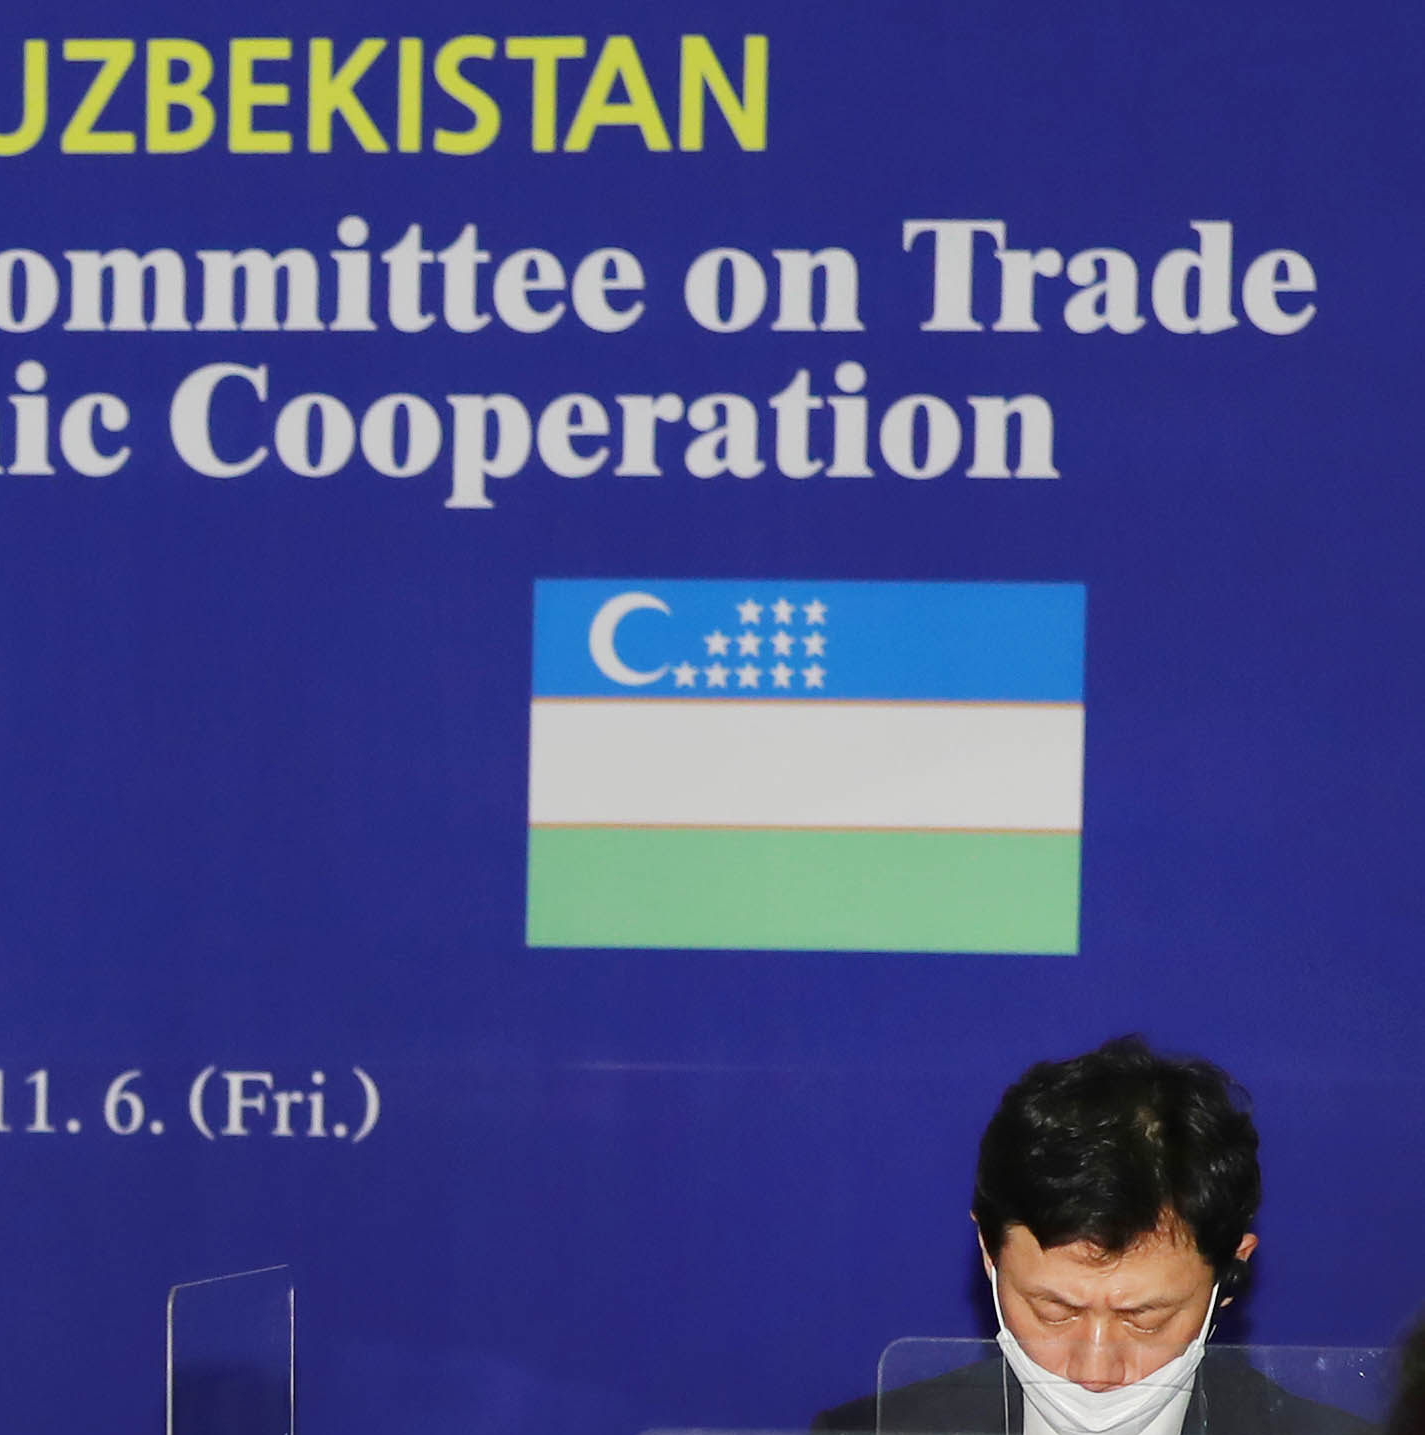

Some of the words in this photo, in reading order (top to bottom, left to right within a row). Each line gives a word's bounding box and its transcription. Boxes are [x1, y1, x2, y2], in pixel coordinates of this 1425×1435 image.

[683, 247, 866, 334] on
[901, 219, 1318, 337] Trade
[168, 361, 1061, 510] Cooperation
[103, 1070, 164, 1136] 6.
[188, 1067, 381, 1142] (Fri.)
